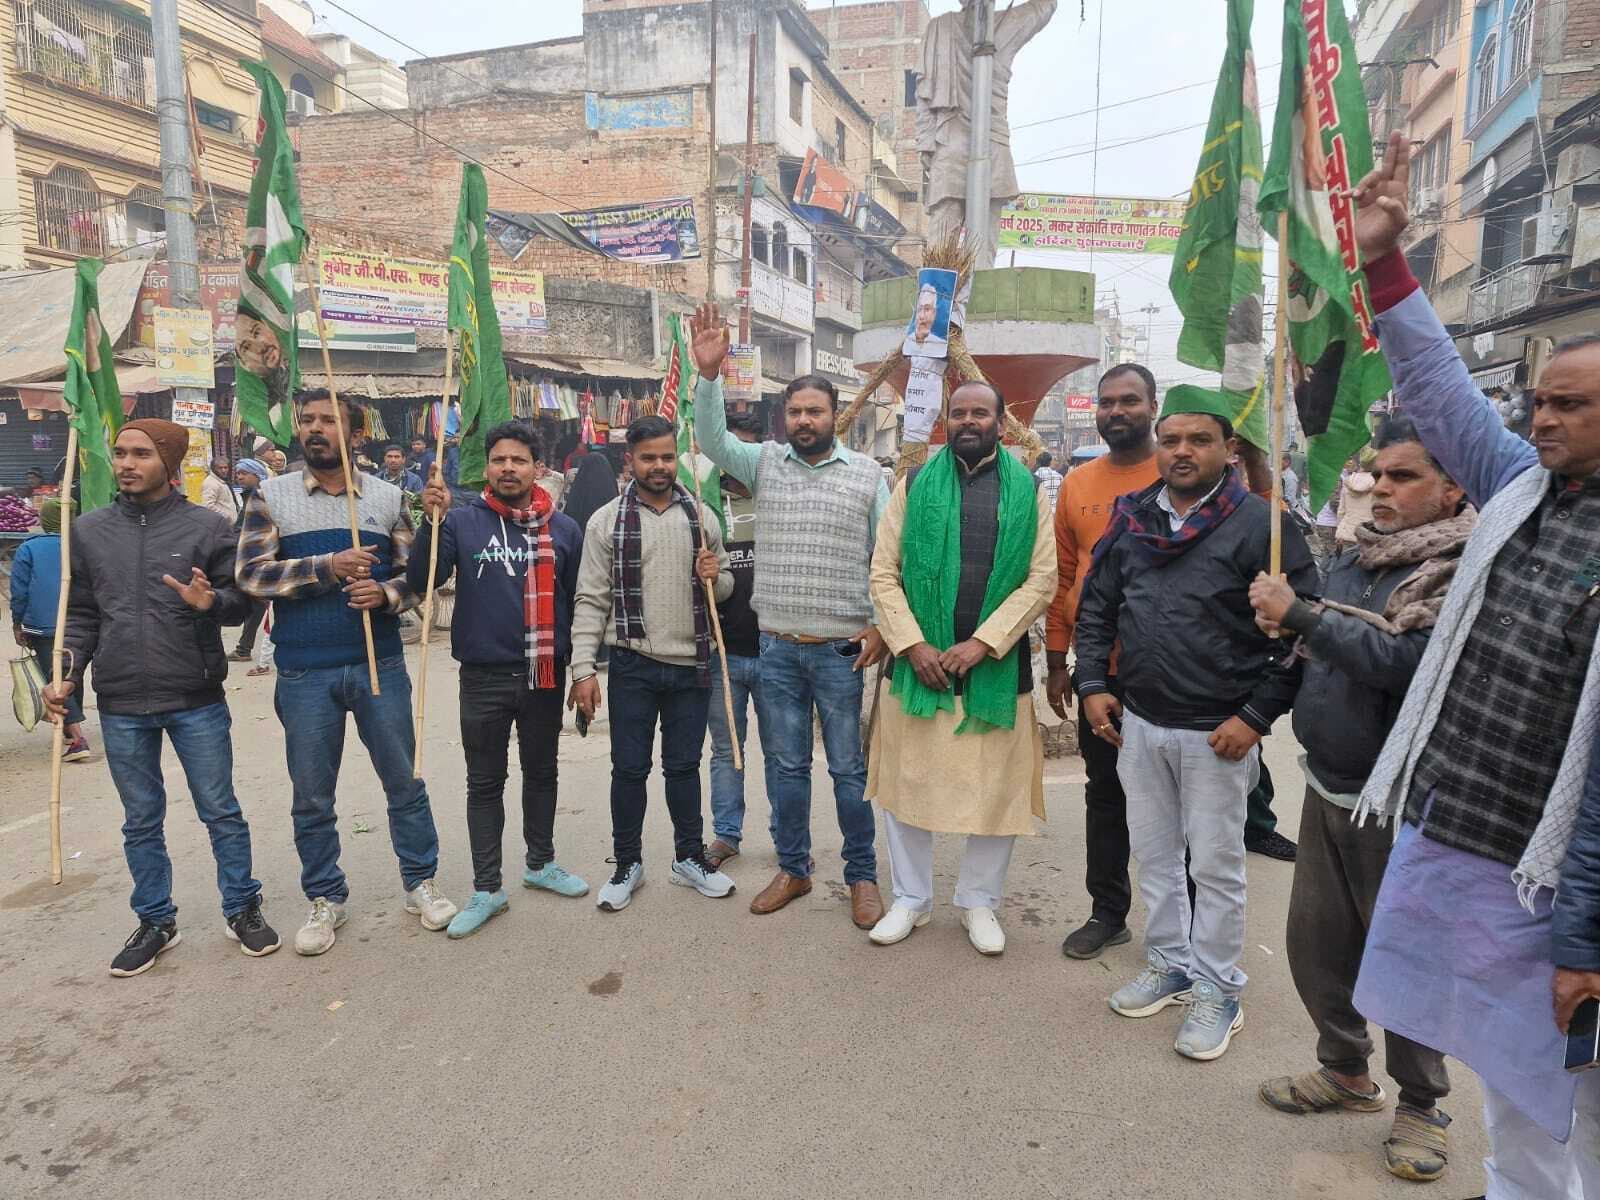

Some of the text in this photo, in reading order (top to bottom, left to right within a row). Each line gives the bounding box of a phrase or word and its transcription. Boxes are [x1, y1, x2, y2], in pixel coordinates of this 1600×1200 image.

[662, 205, 694, 220] WEAR
[1000, 214, 1014, 230] वर्ष
[1016, 218, 1046, 233] 2025,
[1049, 220, 1073, 233] मकर
[1076, 217, 1108, 235] संक्रांति
[1109, 219, 1124, 235] एवं
[1126, 222, 1156, 238] गणतंत्र
[1071, 397, 1088, 407] VIP
[728, 550, 744, 561] ER
